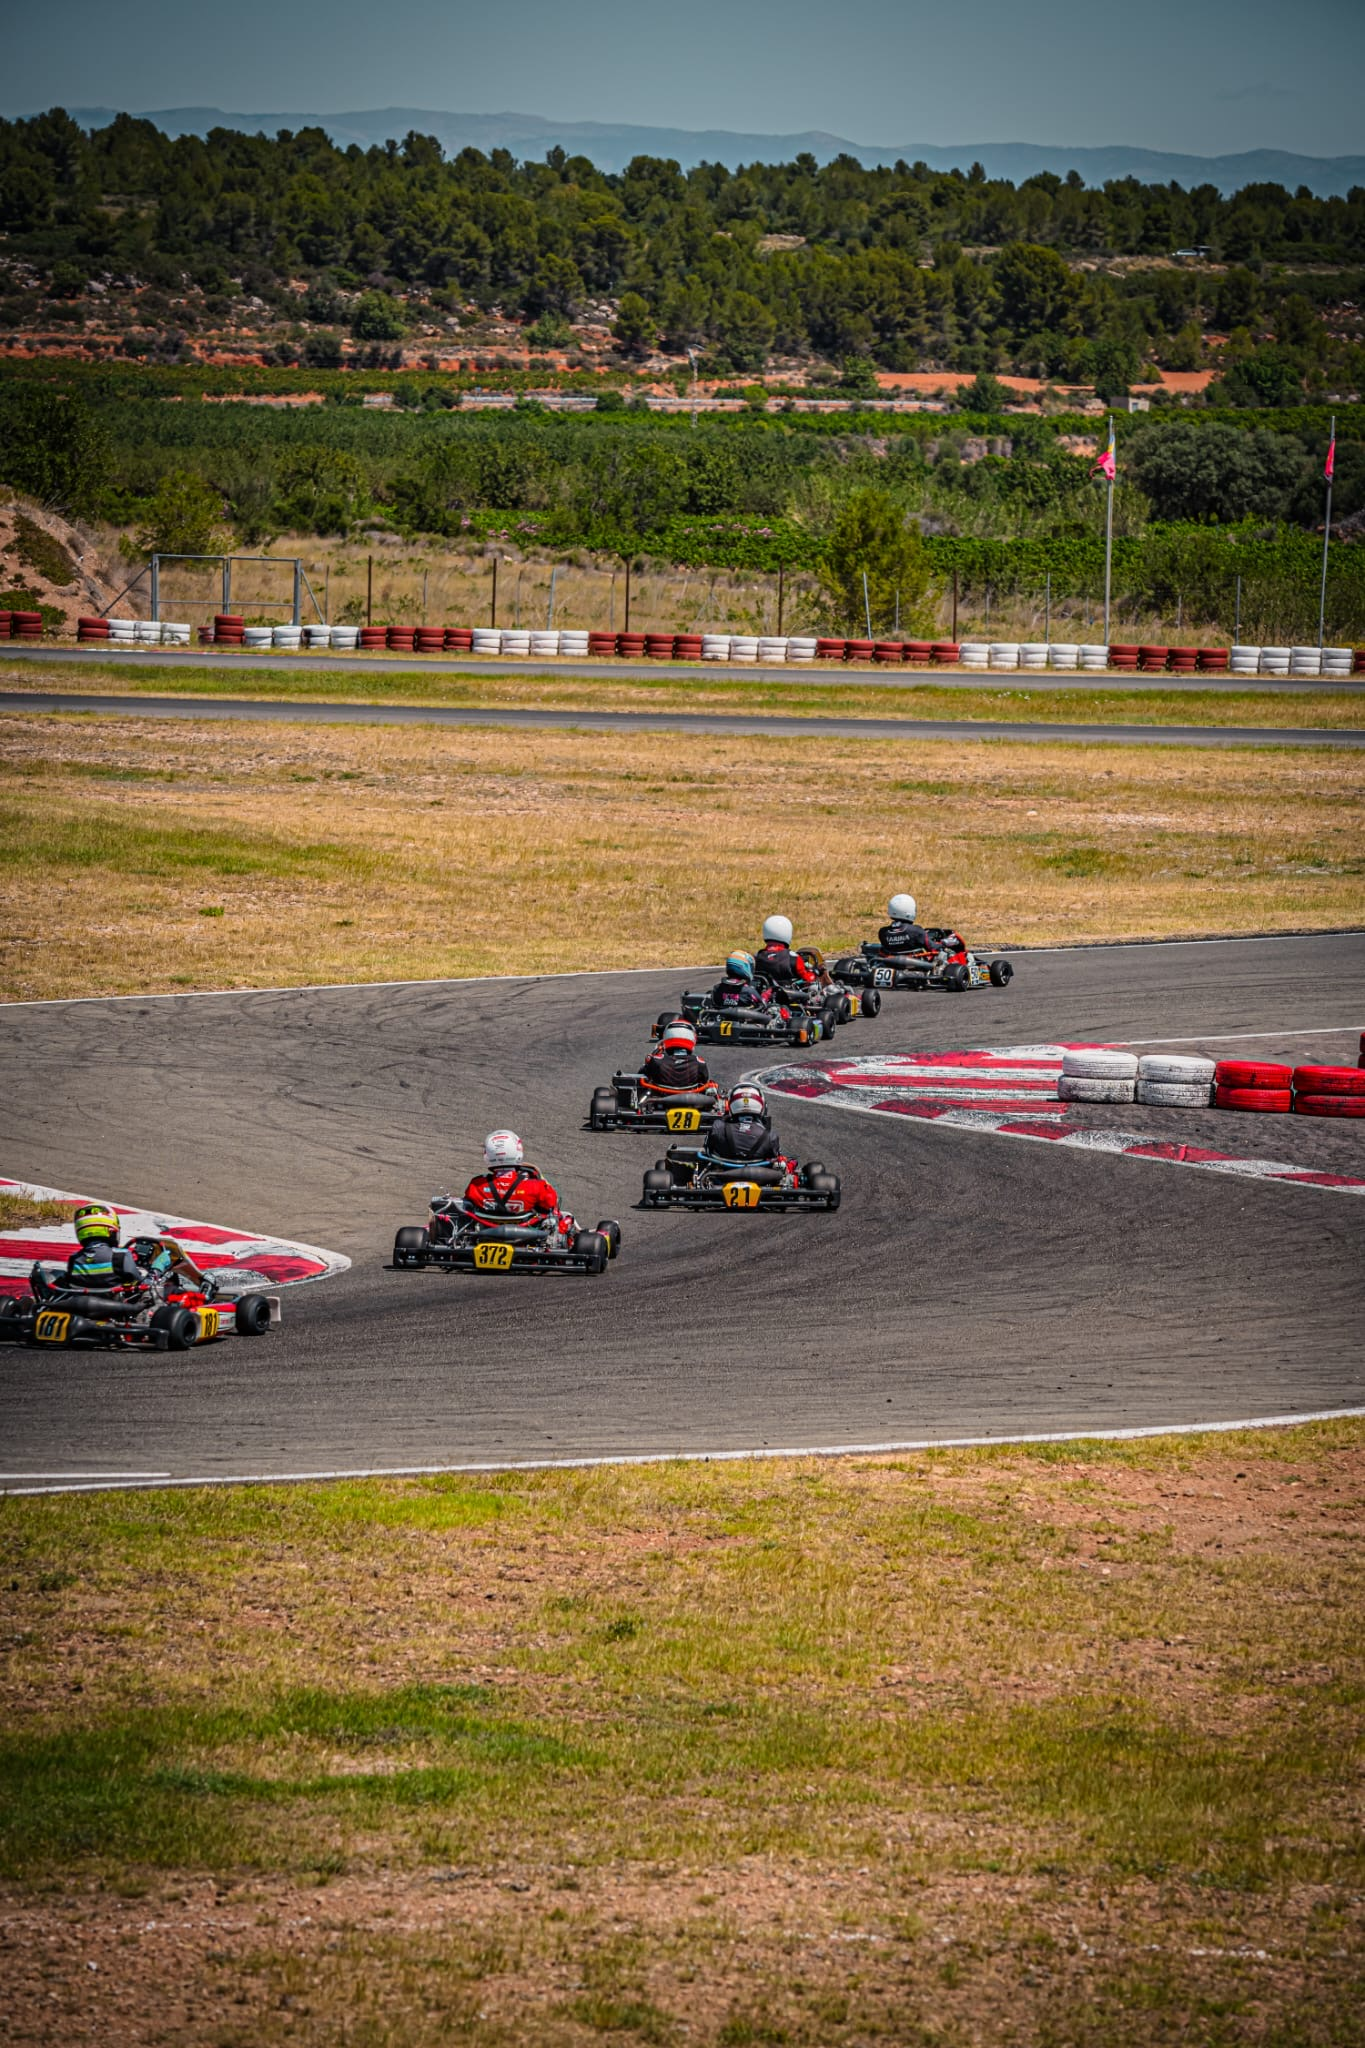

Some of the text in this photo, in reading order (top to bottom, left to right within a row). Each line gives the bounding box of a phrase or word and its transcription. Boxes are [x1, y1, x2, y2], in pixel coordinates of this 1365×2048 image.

[876, 969, 892, 981] 50
[722, 1021, 731, 1035] 7
[672, 1111, 694, 1129] 28
[730, 1186, 751, 1206] 21
[479, 1245, 508, 1266] 372
[38, 1314, 69, 1338] 181
[204, 1312, 217, 1338] 181
